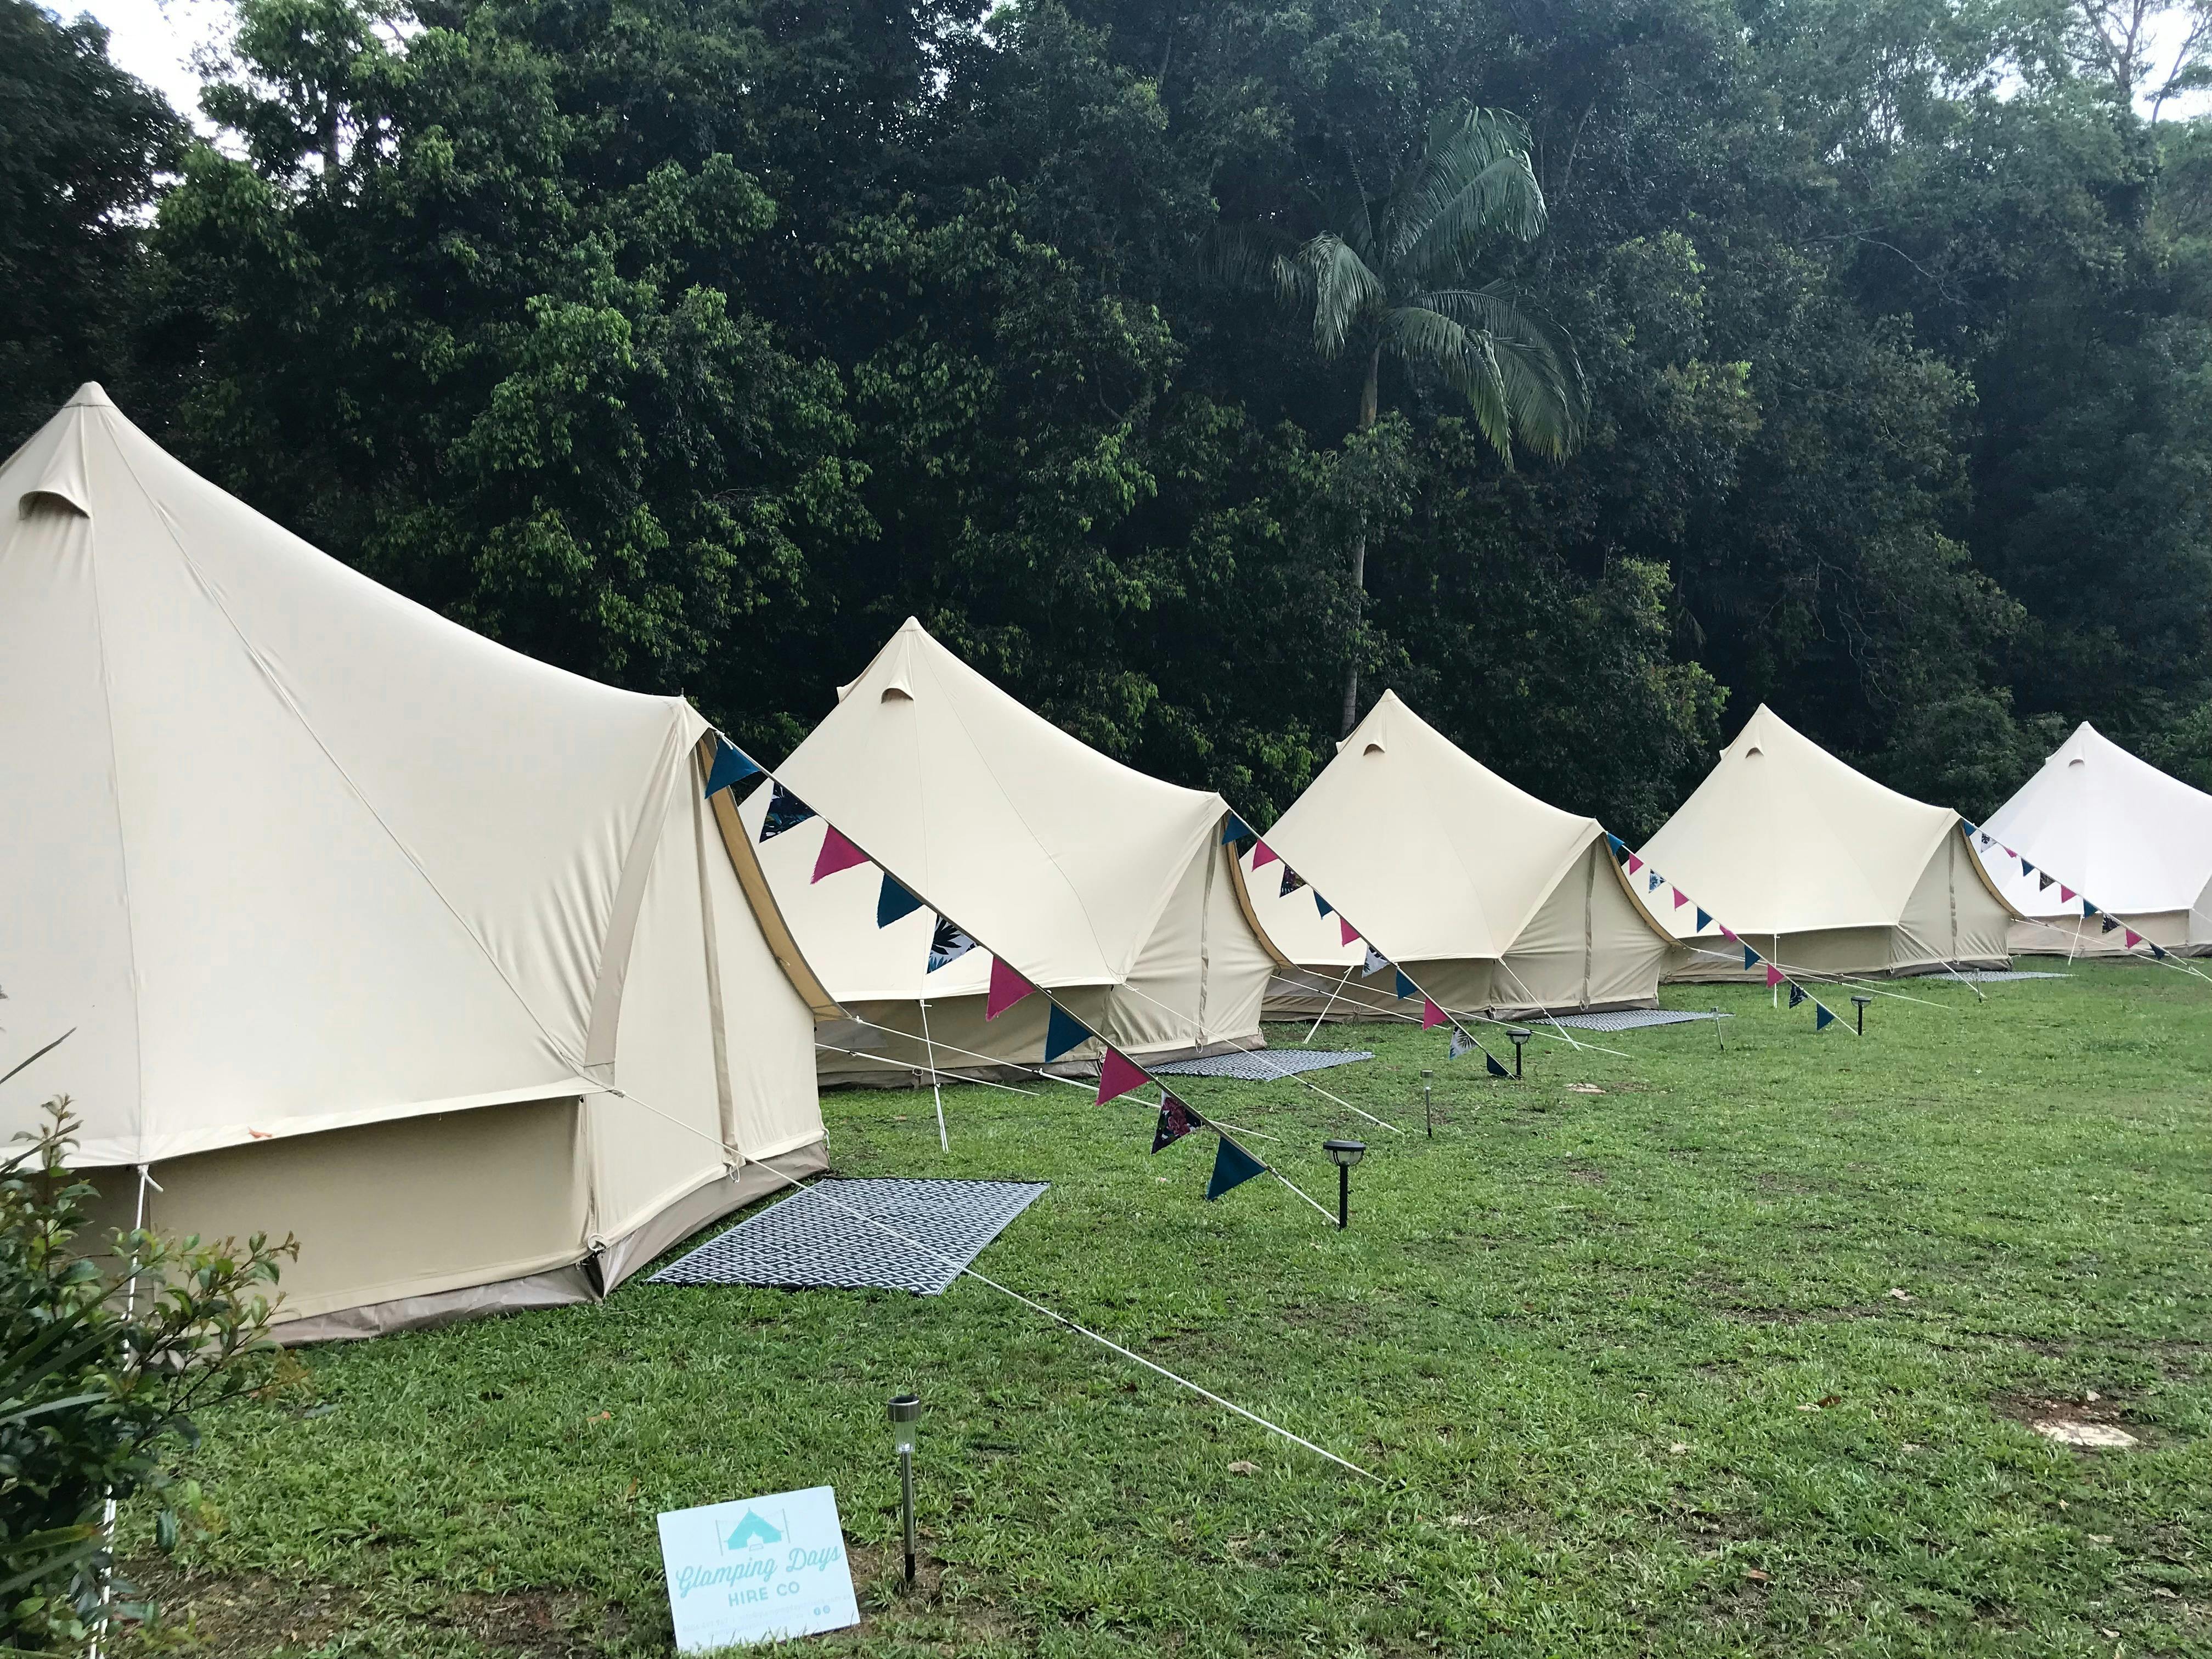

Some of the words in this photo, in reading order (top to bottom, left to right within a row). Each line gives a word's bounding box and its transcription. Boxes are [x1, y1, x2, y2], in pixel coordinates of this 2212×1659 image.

[675, 1557, 777, 1598] Glamping
[786, 1545, 841, 1571] Days
[728, 1586, 769, 1607] HIRE
[776, 1581, 800, 1596] CO
